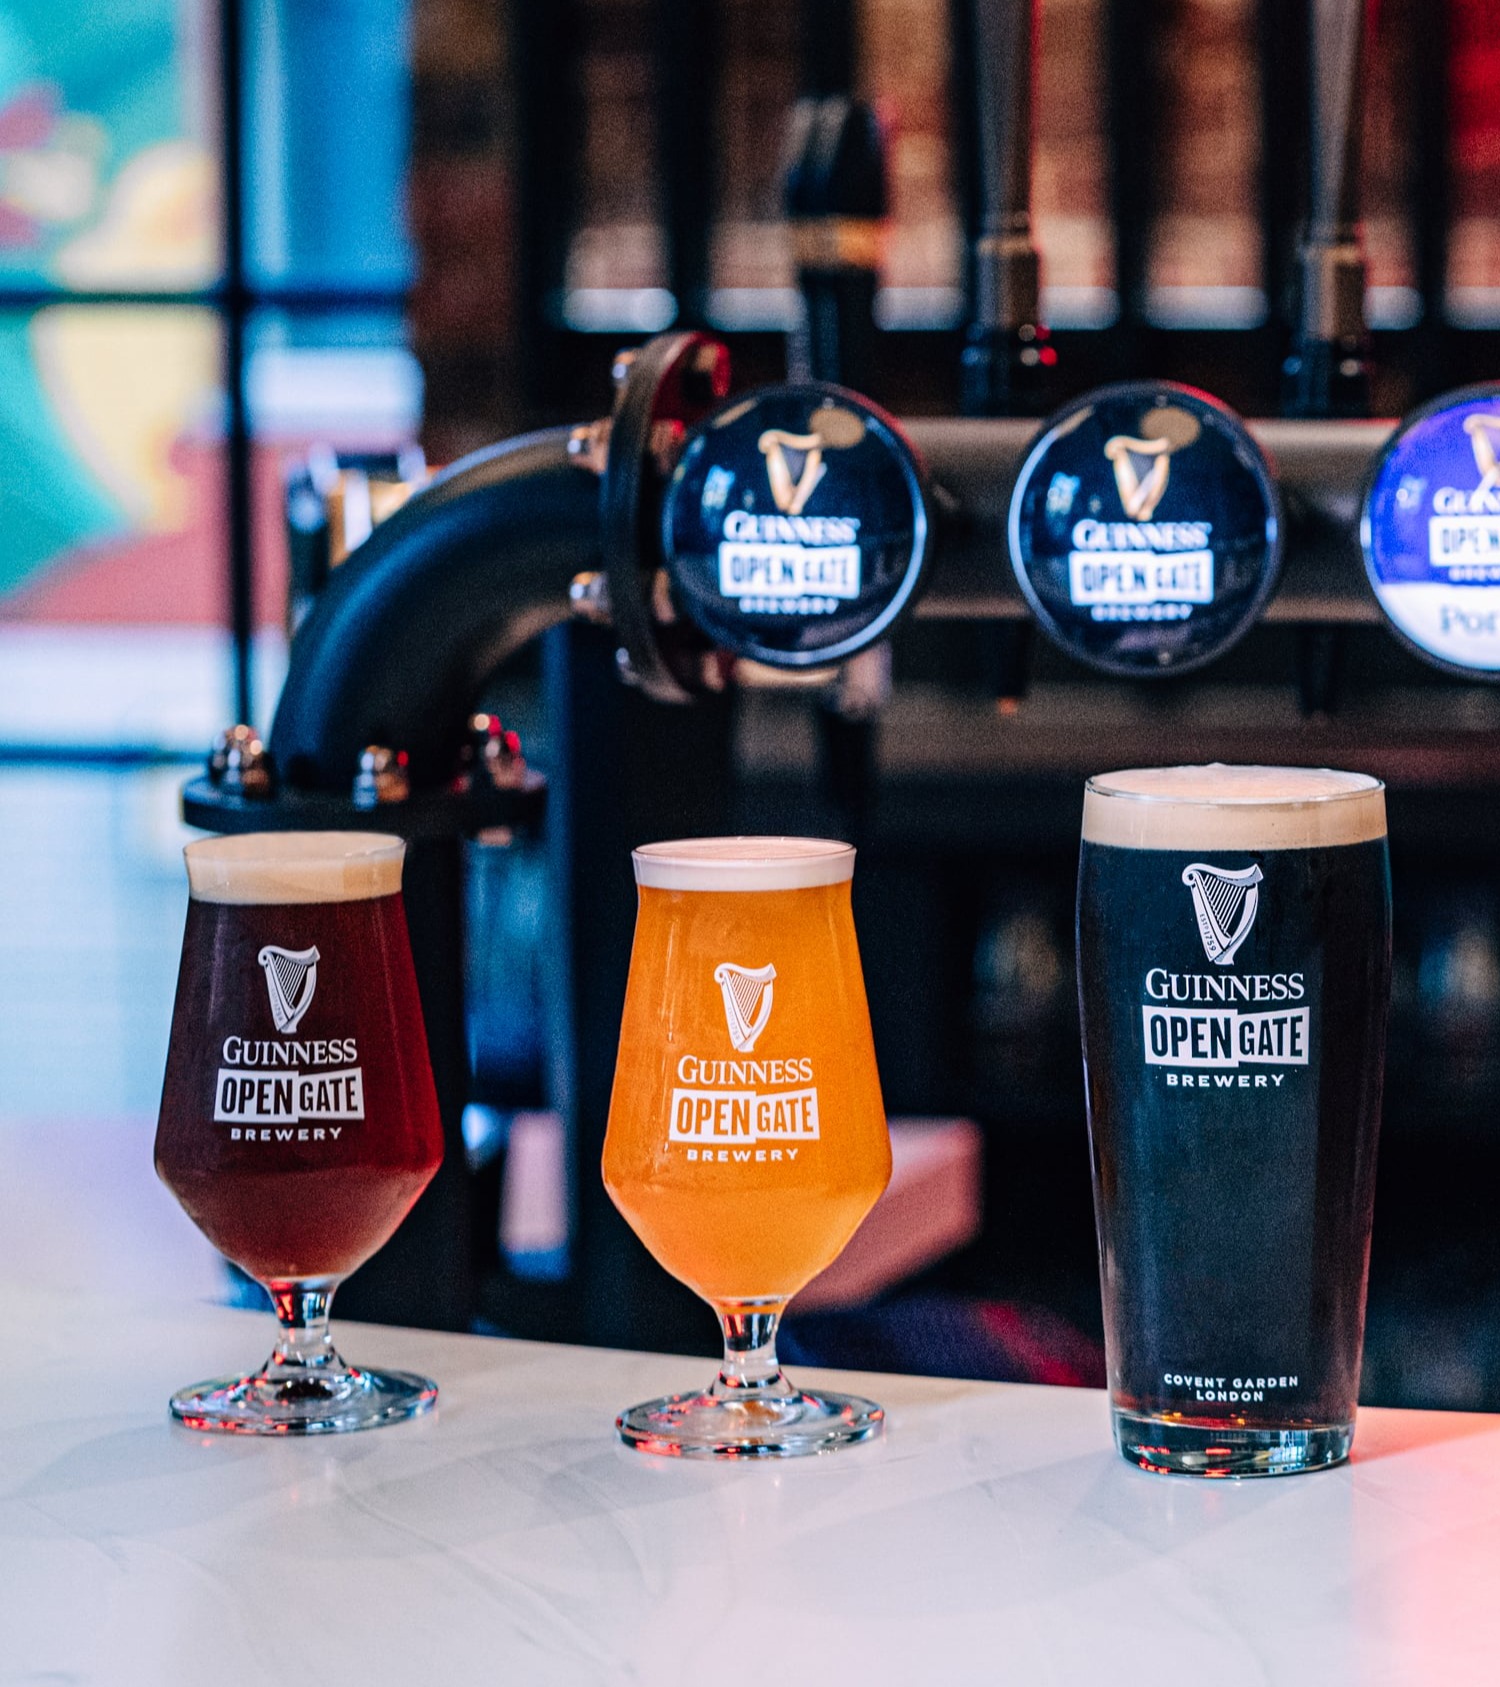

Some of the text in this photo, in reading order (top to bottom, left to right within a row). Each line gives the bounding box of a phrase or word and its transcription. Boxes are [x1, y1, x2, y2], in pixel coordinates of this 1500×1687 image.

[723, 510, 858, 545] GUINNESS
[1072, 518, 1209, 551] GUINNESS
[1441, 527, 1500, 554] OPEN
[730, 555, 795, 584] OPEN
[1081, 563, 1147, 592] OPEN
[1145, 968, 1305, 1001] GUINNESS
[223, 1036, 357, 1065] GUINNESS
[1150, 1014, 1303, 1059] OPEN GATE
[678, 1055, 813, 1084] GUINNESS
[1166, 1073, 1285, 1088] BREWERY
[221, 1076, 358, 1115] OPEN GATE
[676, 1096, 813, 1136] OPEN GATE
[231, 1127, 342, 1141] BREWERY
[687, 1148, 798, 1162] BREWERY
[1164, 1373, 1298, 1389] COVENT GARDEN
[1196, 1390, 1264, 1402] LONDON
